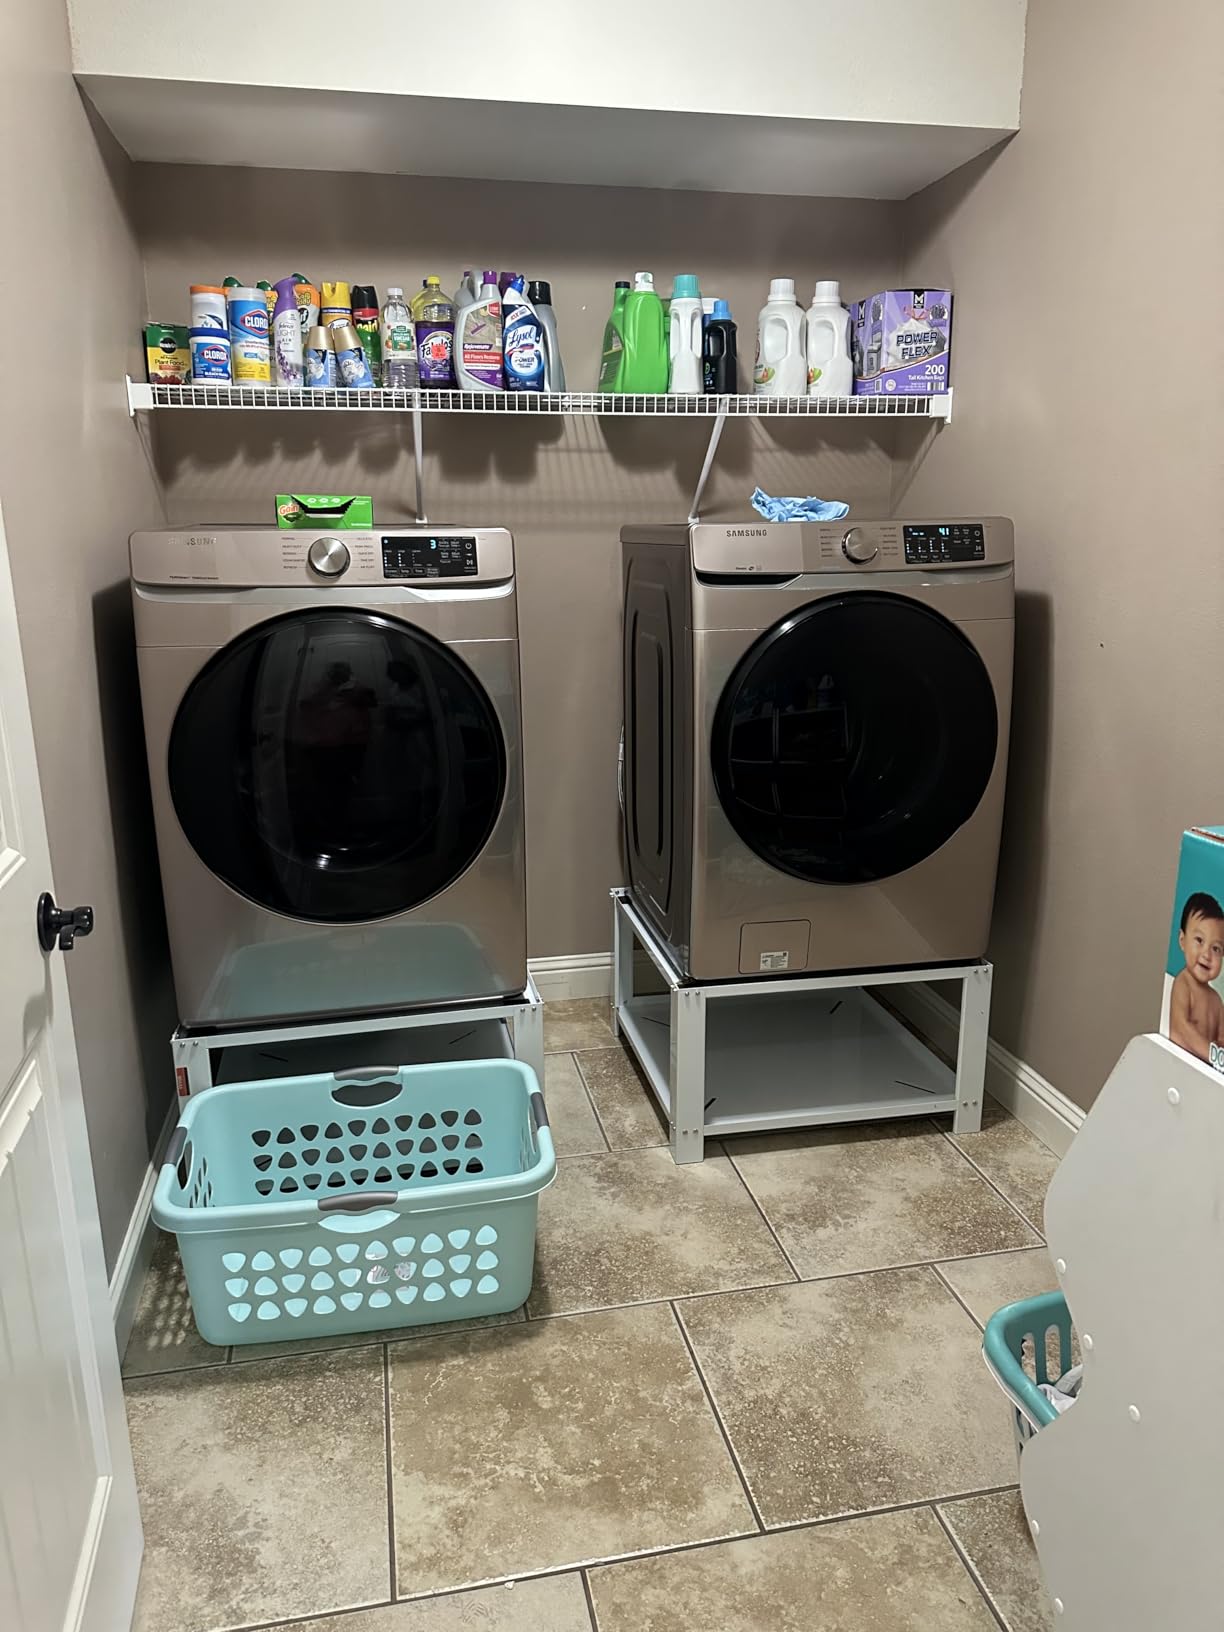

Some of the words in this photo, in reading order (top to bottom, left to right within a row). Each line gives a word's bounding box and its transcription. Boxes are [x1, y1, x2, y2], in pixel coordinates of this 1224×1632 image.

[508, 326, 535, 347] Lysol
[896, 332, 938, 346] POWER
[901, 345, 931, 359] FLEX
[924, 364, 945, 375] 200
[279, 503, 299, 515] Gain
[726, 529, 768, 537] SAMSUNG
[430, 539, 437, 550] 3
